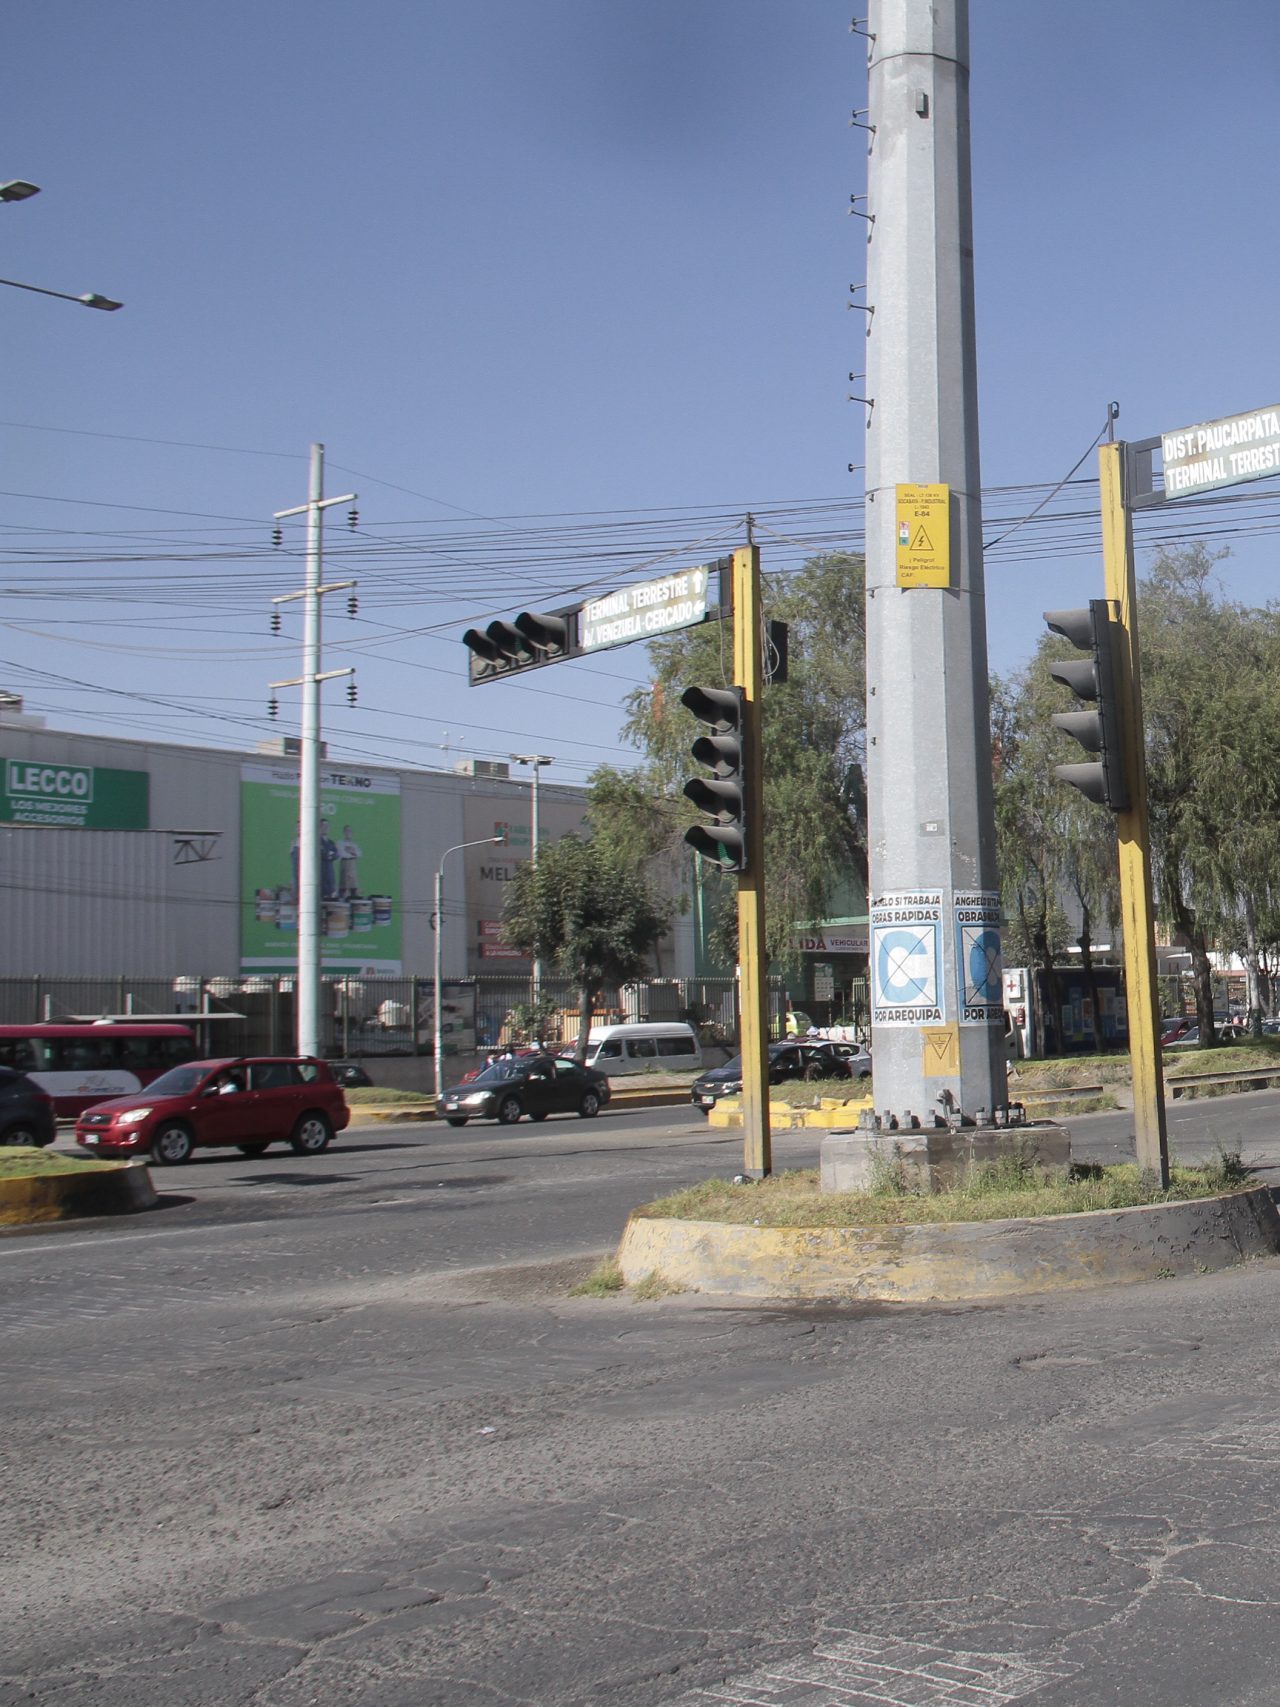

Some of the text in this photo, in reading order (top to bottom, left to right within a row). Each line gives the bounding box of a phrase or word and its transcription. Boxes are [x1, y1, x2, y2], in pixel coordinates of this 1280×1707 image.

[1166, 459, 1227, 491] TERMINAL
[586, 576, 688, 622] TERMINAL TERRESTRE
[11, 766, 88, 795] LECCO
[11, 800, 88, 814] LOS MEJORES
[14, 812, 86, 825] ACCESORIOS
[894, 896, 901, 906] SI
[902, 895, 941, 906] TRABAJA
[871, 909, 939, 924] OBRAS RAPIDAS
[958, 911, 987, 922] OBRAS
[830, 938, 868, 947] VEHICULAR
[874, 1008, 942, 1022] POR AREQUIPA
[963, 1008, 984, 1021] POR
